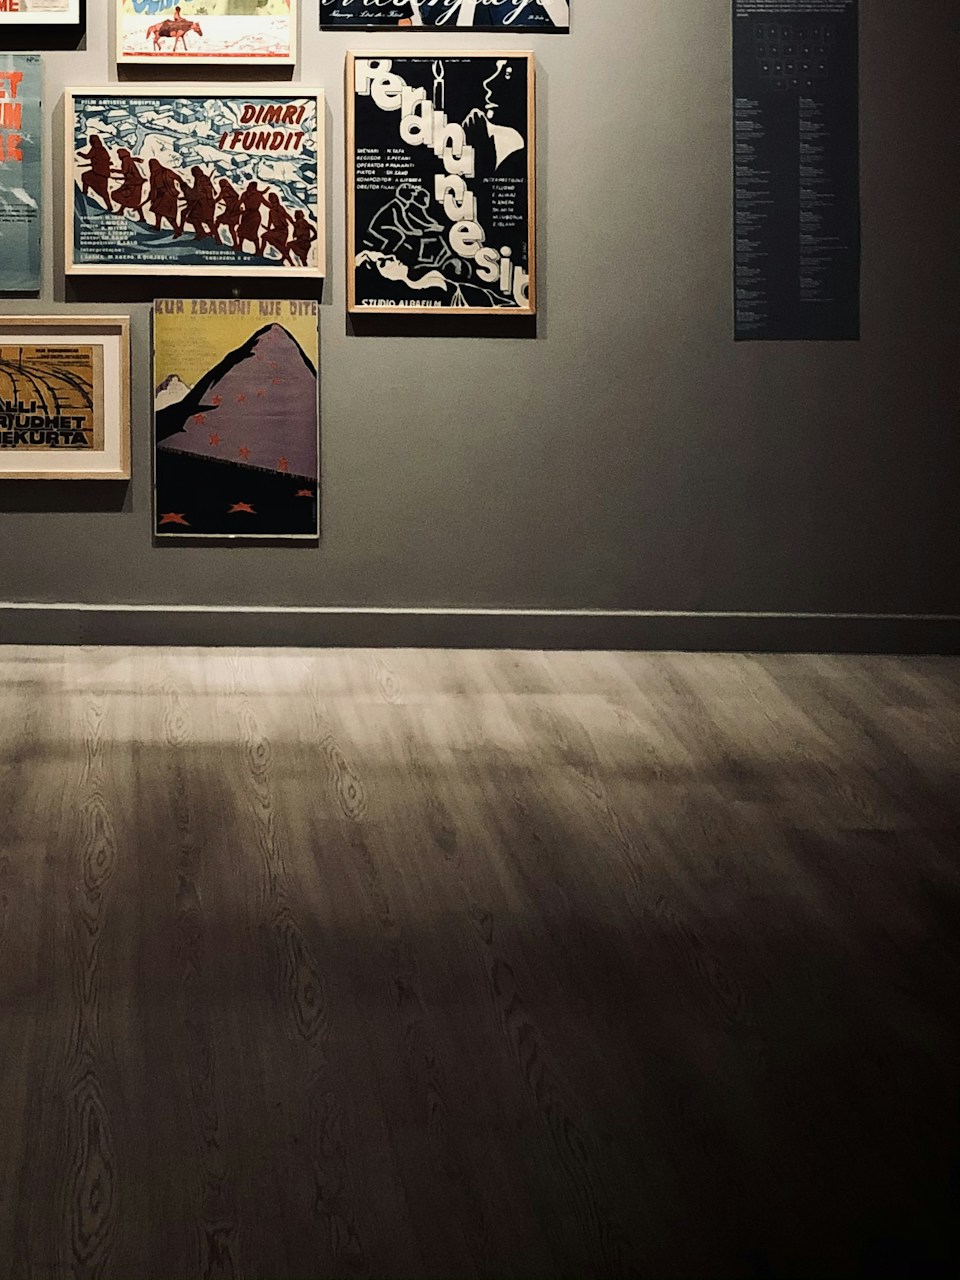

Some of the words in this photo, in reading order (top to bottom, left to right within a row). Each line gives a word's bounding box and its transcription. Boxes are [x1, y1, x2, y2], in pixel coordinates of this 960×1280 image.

[240, 104, 306, 125] DIMRI
[218, 131, 228, 151] I
[229, 131, 306, 151] FUNDIT
[155, 300, 185, 314] KUR
[258, 300, 282, 316] NJE
[290, 301, 317, 317] DITE
[360, 298, 394, 306] STUDIO
[14, 416, 87, 430] UDHET
